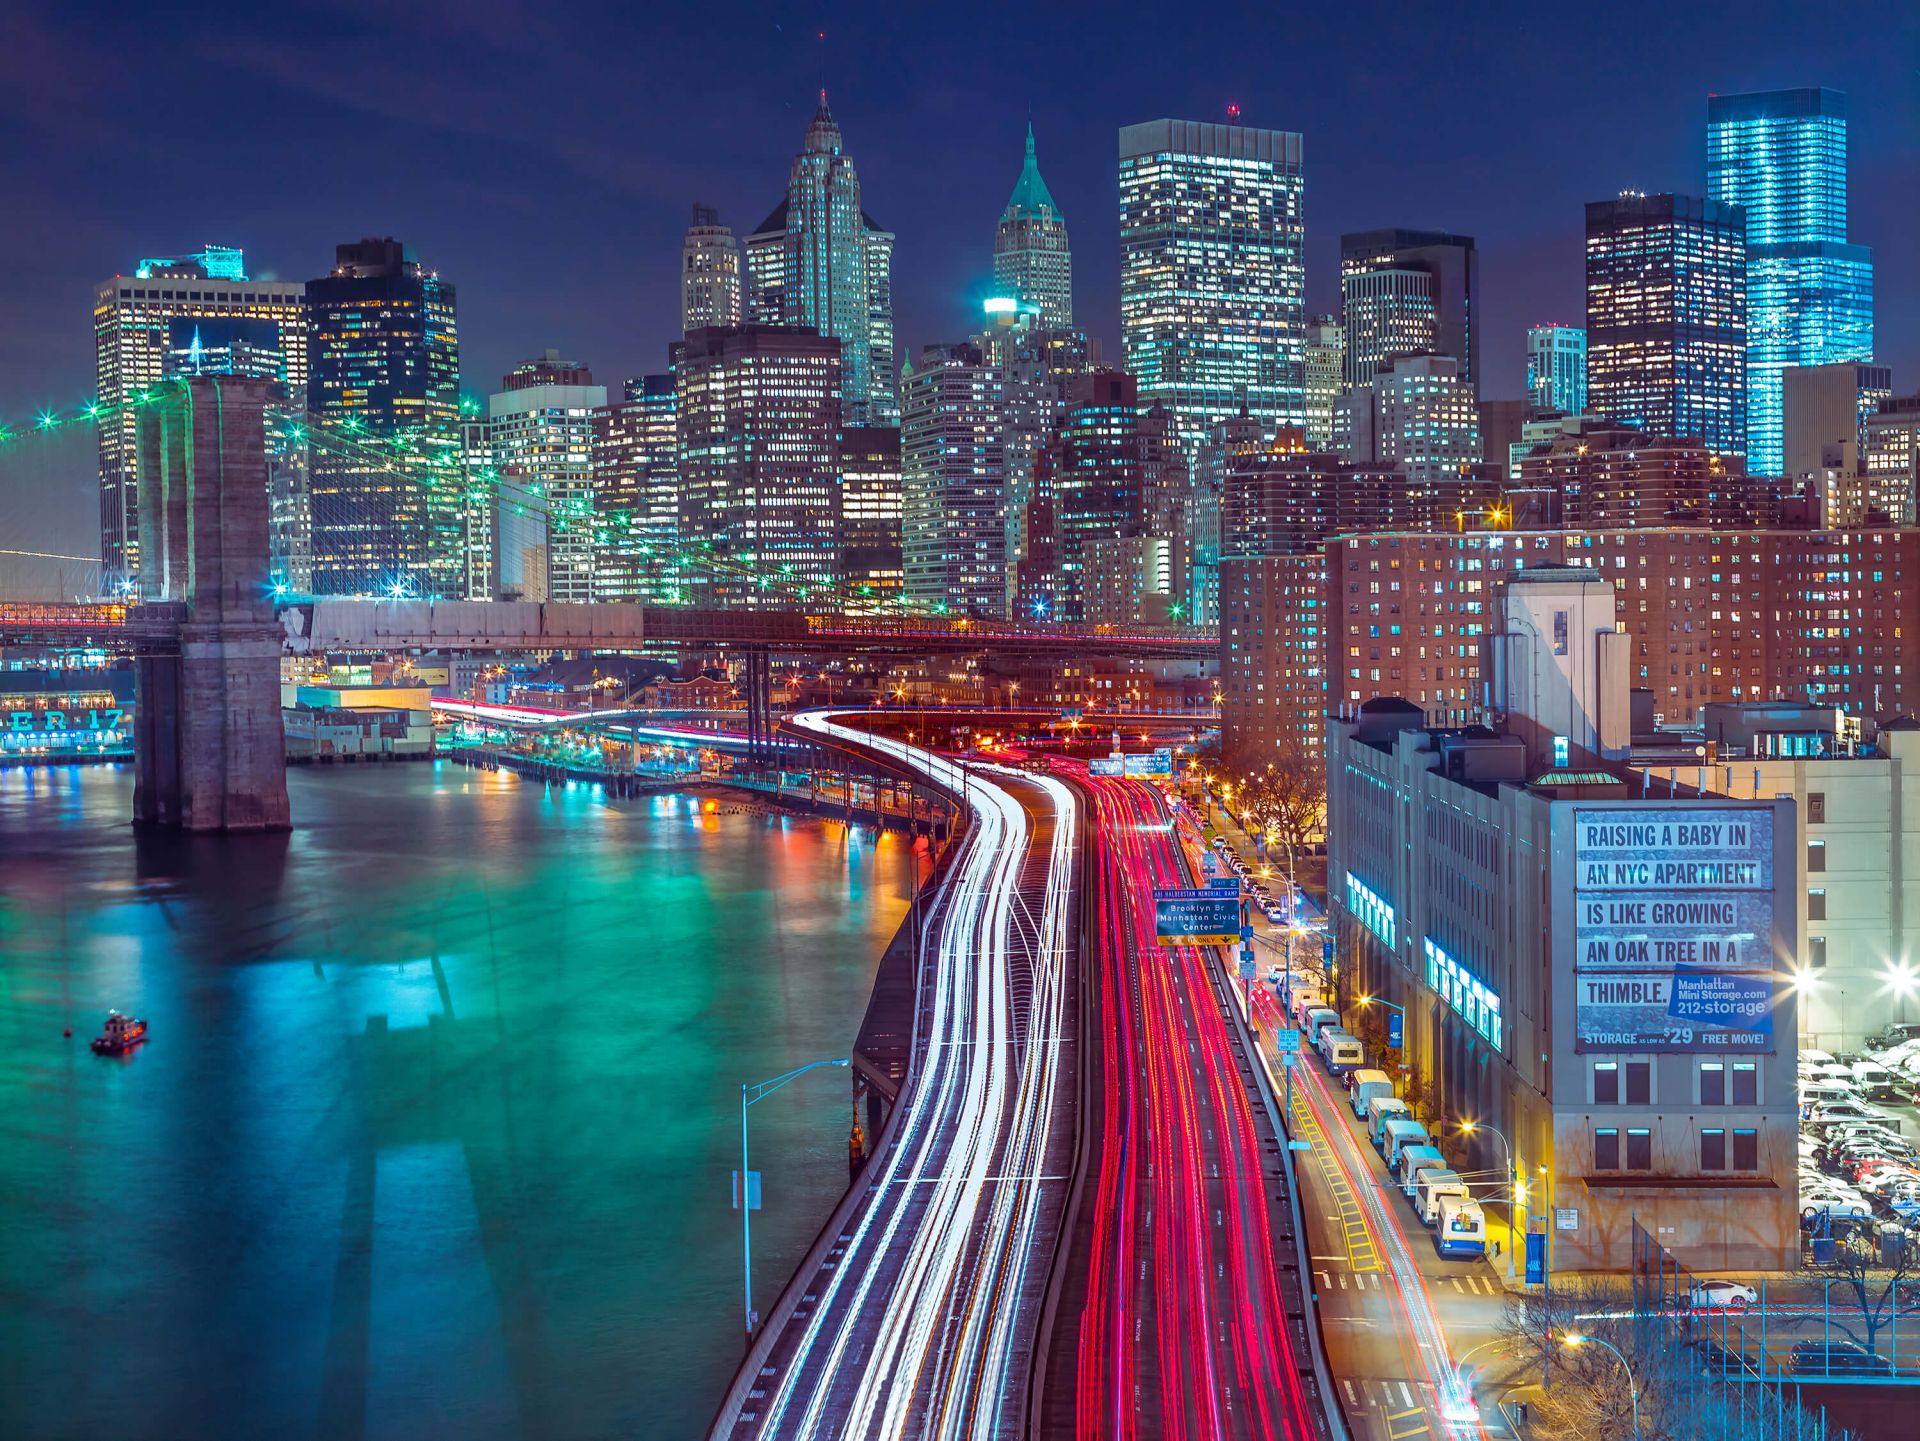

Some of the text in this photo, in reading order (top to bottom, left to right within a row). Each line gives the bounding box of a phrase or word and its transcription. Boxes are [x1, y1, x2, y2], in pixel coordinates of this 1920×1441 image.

[89, 709, 124, 728] 17
[1587, 825, 1746, 846] RAISING A BABY IN
[1587, 863, 1756, 884] AN NYC APARTMENT
[1587, 903, 1734, 924] IS LIKE GROWING
[1587, 942, 1736, 962] AN OAK TREE IN A
[1587, 983, 1668, 1004] THIMBLE.
[1678, 978, 1734, 990] Manhattan
[1678, 990, 1766, 1000] Mini Storage.com
[1584, 1033, 1637, 1044] STORAGE
[1664, 1027, 1693, 1044] $29
[1702, 1034, 1728, 1044] FREE
[1731, 1034, 1764, 1044] MOVE!
